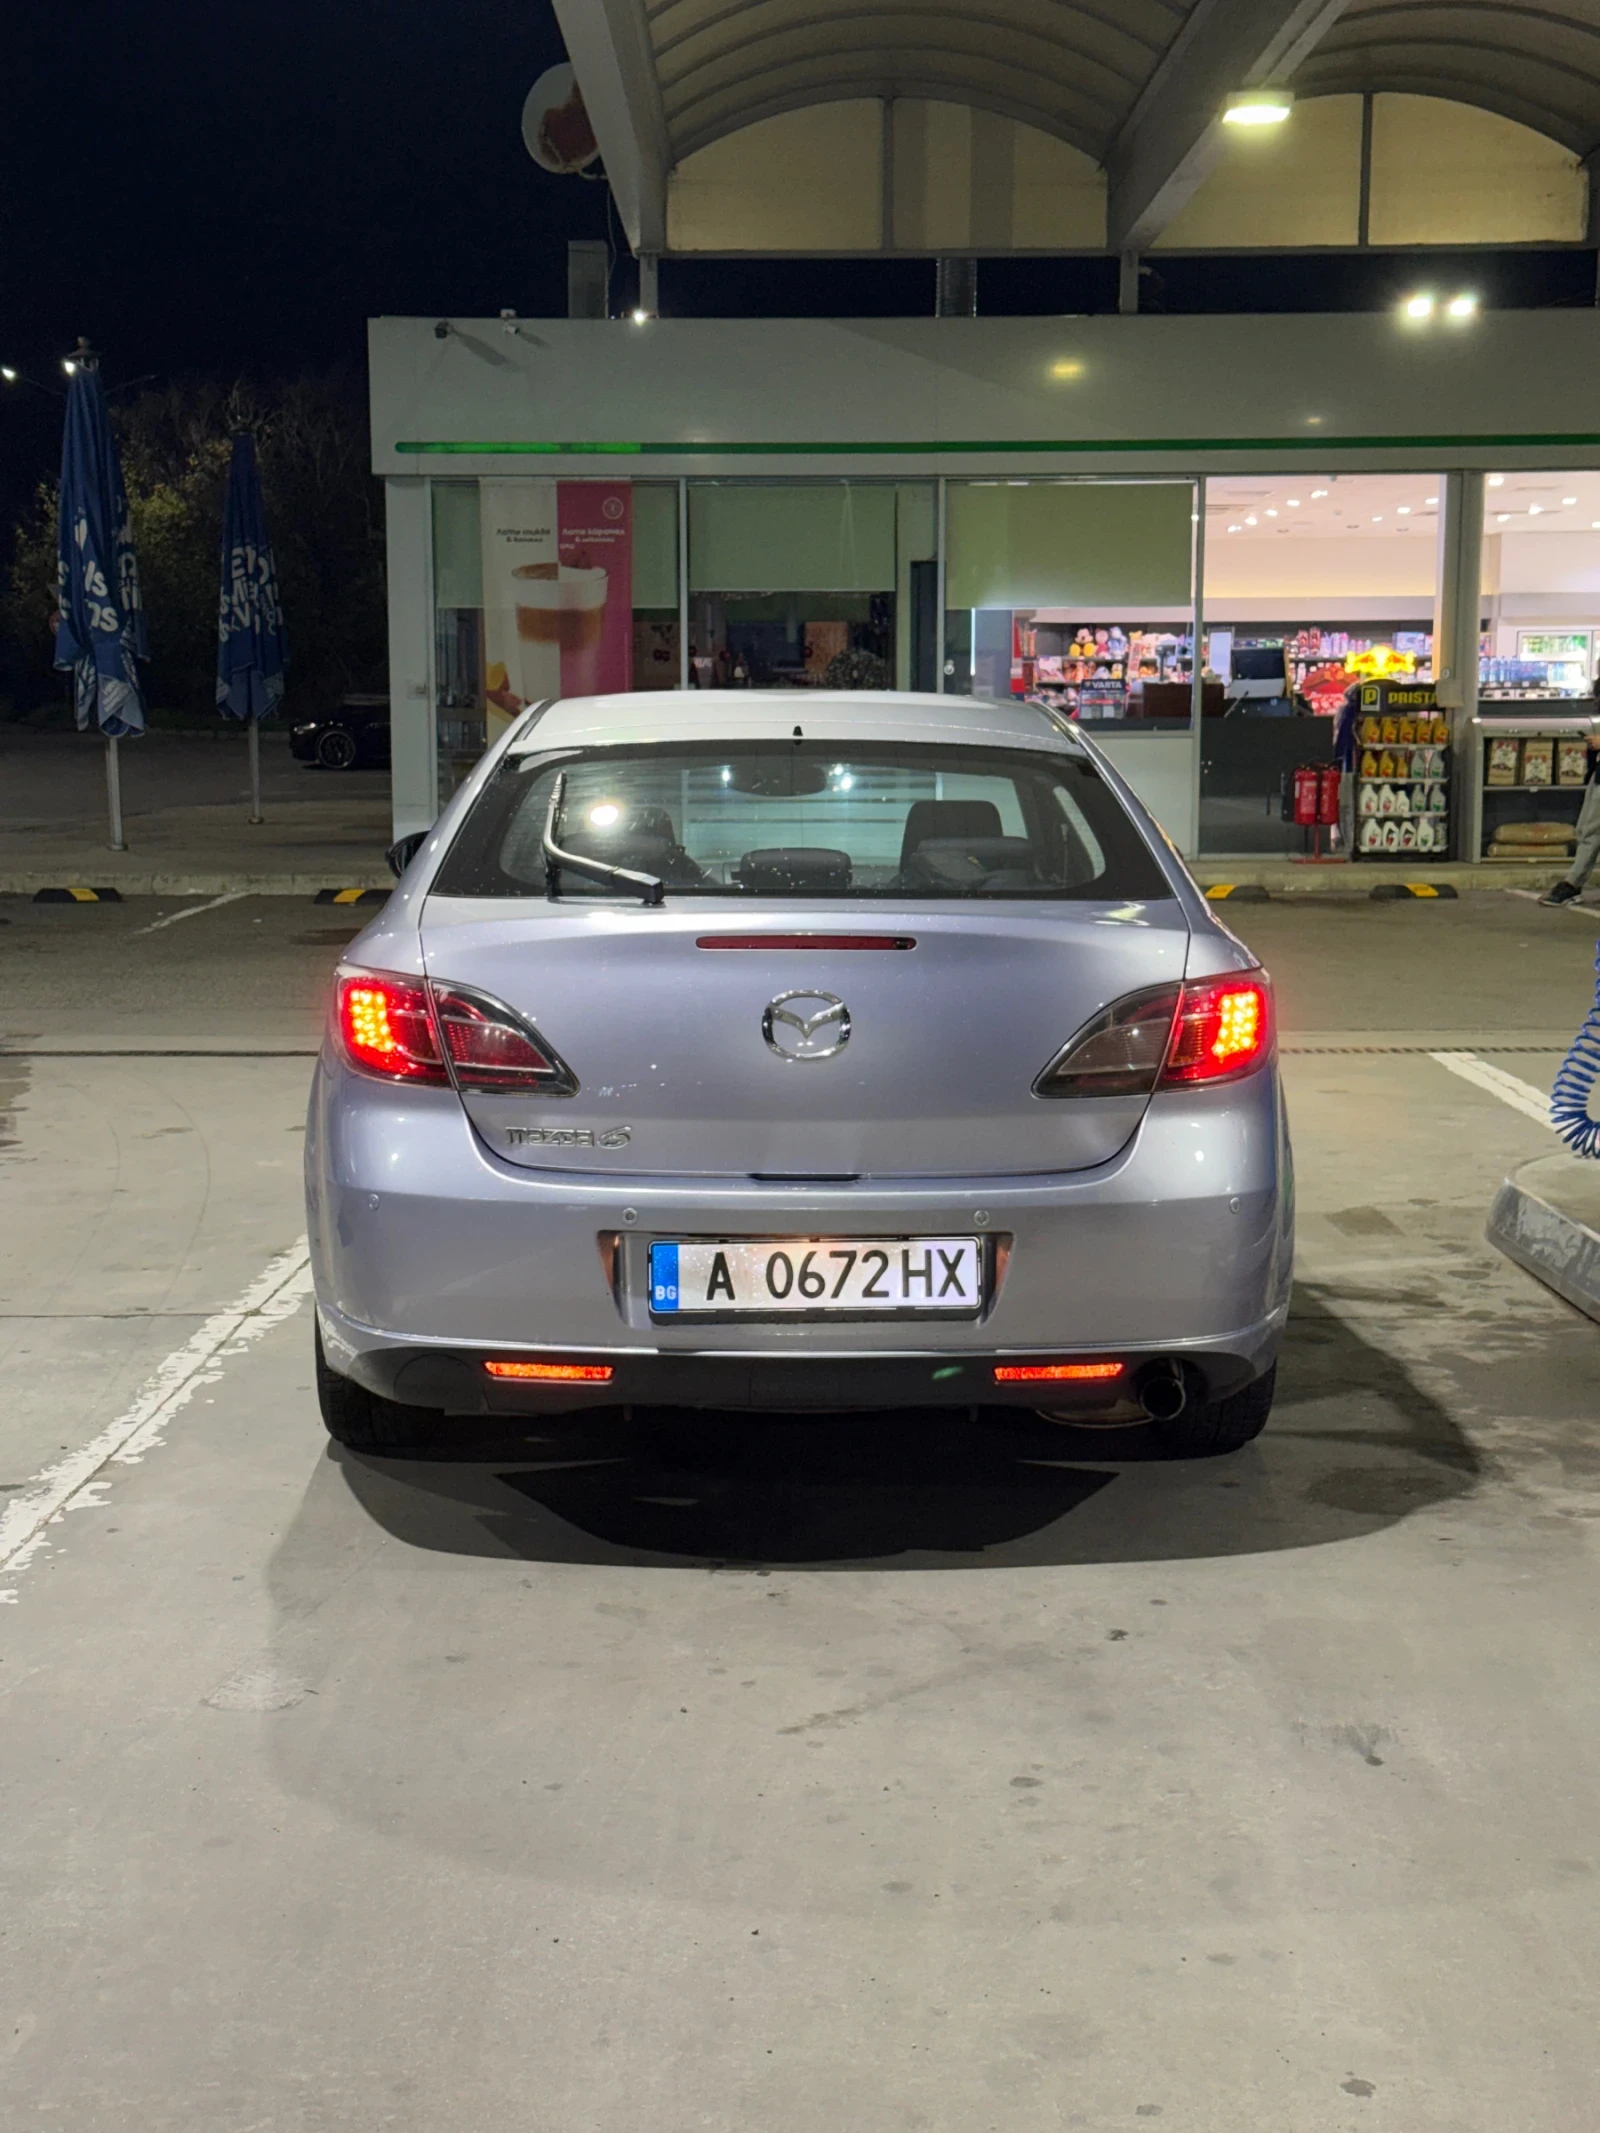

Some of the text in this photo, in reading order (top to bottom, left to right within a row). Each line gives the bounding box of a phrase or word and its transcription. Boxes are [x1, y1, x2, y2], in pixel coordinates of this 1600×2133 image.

[1092, 680, 1123, 689] VARTA
[705, 1251, 736, 1301] A
[654, 1285, 677, 1301] BG
